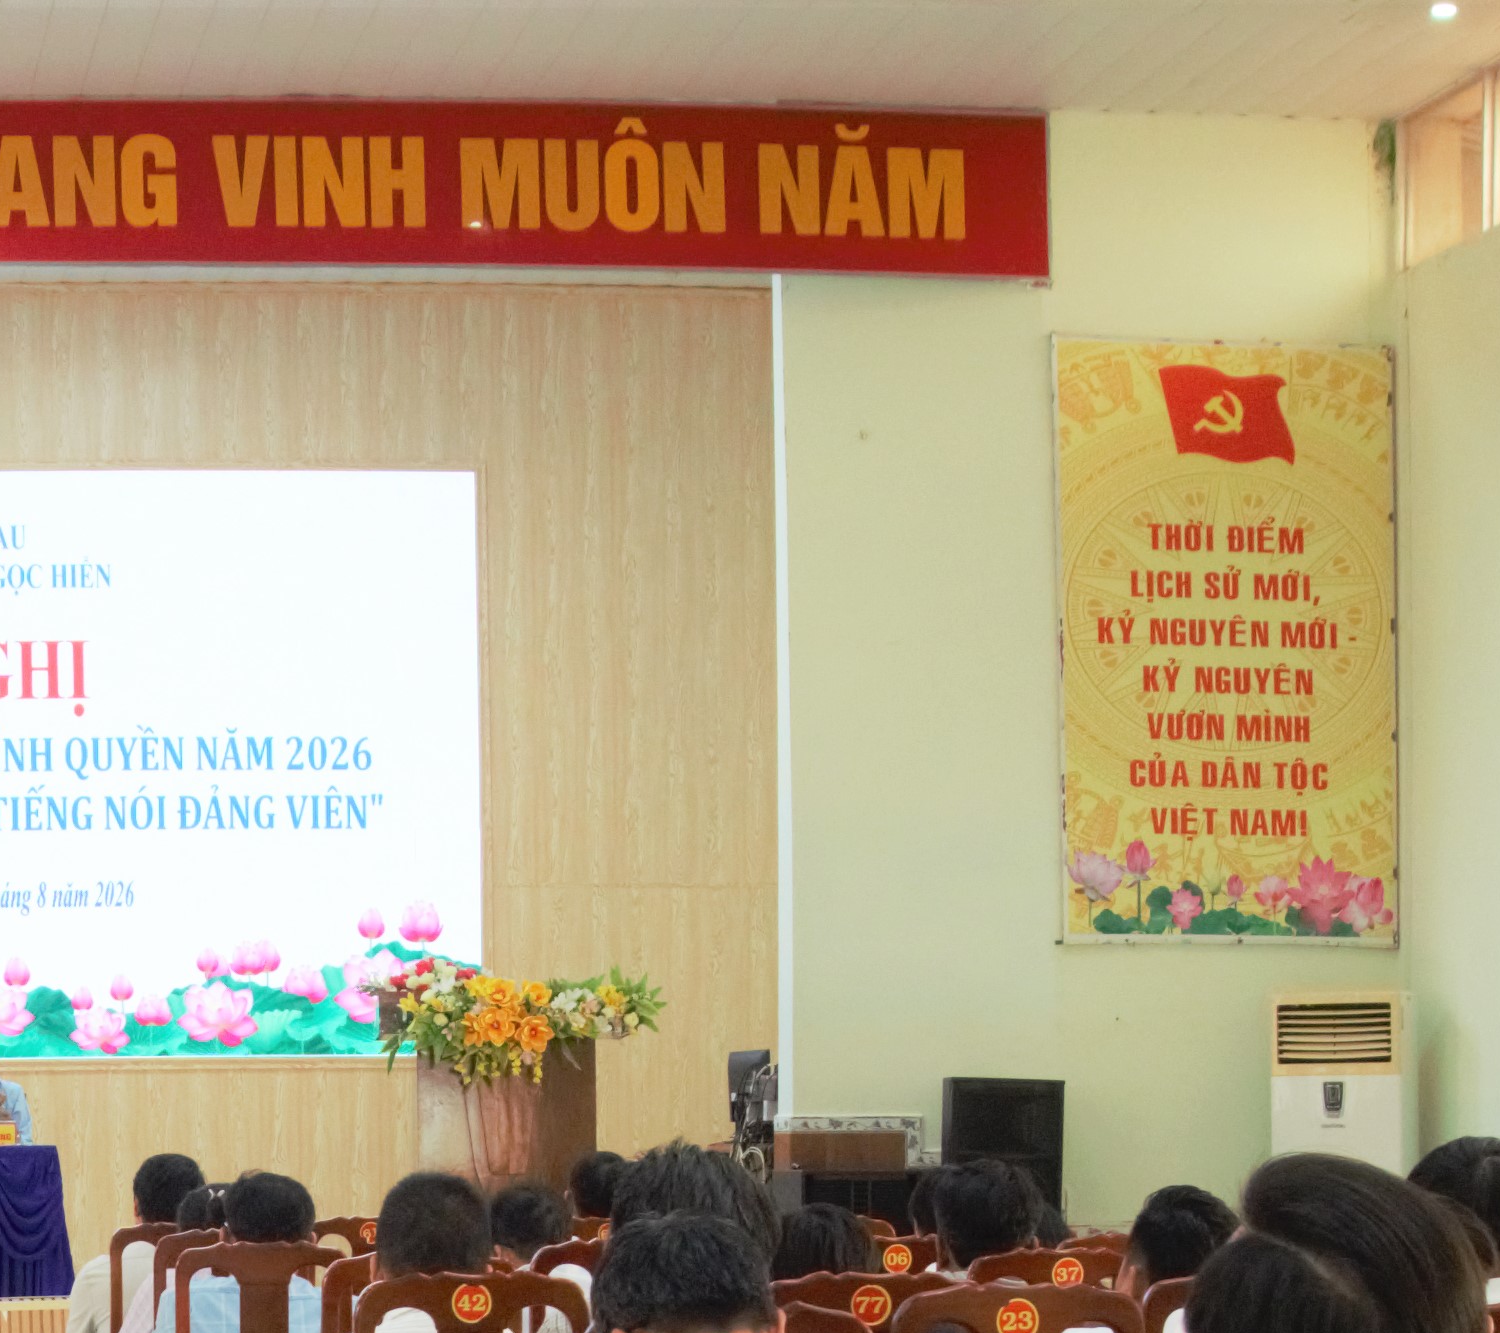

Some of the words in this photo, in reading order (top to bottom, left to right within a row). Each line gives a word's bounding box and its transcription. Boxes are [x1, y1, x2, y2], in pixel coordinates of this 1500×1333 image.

[212, 135, 426, 228] VINH
[460, 117, 726, 233] MUÔN
[758, 124, 965, 240] NĂM
[1147, 520, 1214, 553] THỜI
[1227, 516, 1304, 555] ĐIỂM
[1130, 570, 1193, 604] LỊCH
[1204, 565, 1242, 600] SỬ
[1254, 568, 1321, 607] MỚI,
[1097, 609, 1134, 645] KỶ
[1150, 611, 1269, 648] NGUYÊN
[1280, 618, 1337, 650] MỚI
[1143, 659, 1179, 693] KỶ
[1195, 661, 1314, 697] NGUYÊN
[1147, 710, 1225, 742] VƯƠN
[1235, 710, 1311, 744] MÌNH
[65, 725, 184, 780] QUYỀN
[196, 728, 274, 771] NĂM
[286, 736, 372, 771] 2026
[1129, 752, 1189, 788] CỦA
[1201, 756, 1262, 790] DÂN
[1273, 758, 1329, 796] TỘC
[104, 785, 166, 830] NÓI
[177, 784, 276, 830] ĐẢNG
[1151, 803, 1218, 841] VIỆT
[1230, 808, 1308, 838] NAM!
[887, 1252, 908, 1265] 06
[1057, 1266, 1079, 1281] 37
[456, 1294, 487, 1312] 42
[855, 1296, 885, 1314] 77
[1002, 1310, 1034, 1331] 23
